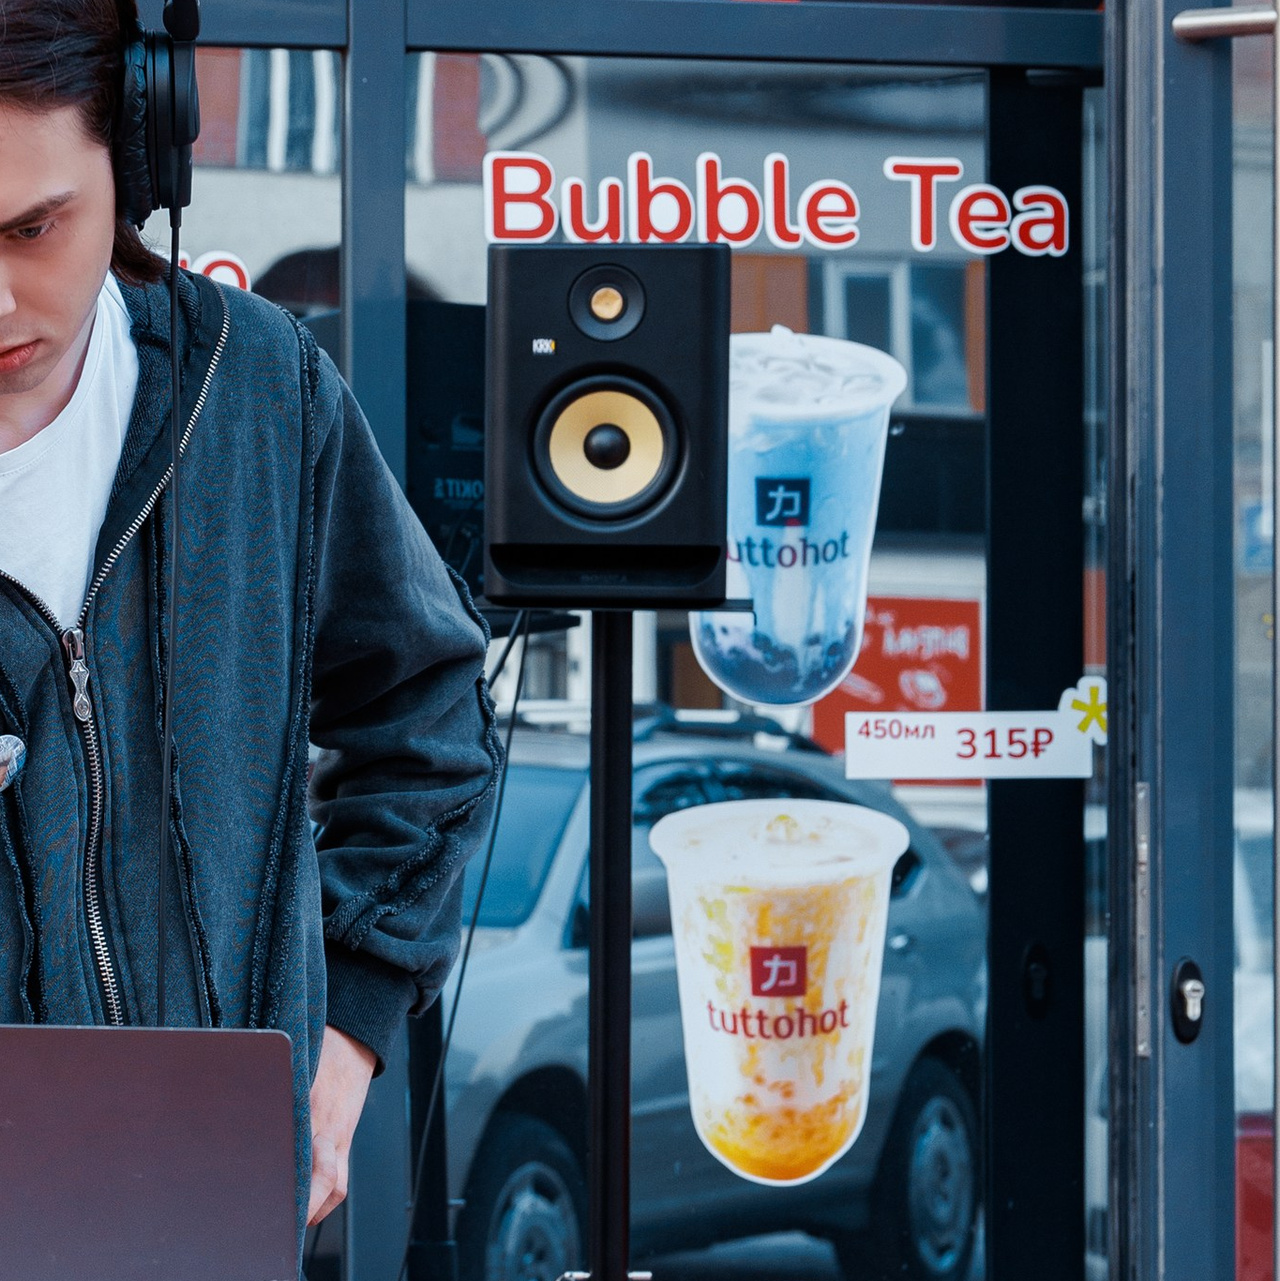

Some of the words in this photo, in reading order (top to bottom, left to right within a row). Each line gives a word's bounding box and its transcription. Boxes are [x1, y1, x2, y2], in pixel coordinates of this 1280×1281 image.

[488, 154, 860, 248] Bubble
[888, 160, 1068, 254] Tea
[727, 530, 851, 569] uttohot
[857, 719, 936, 739] 450мл
[956, 728, 1055, 759] 315₽
[707, 998, 850, 1040] tuttohot
